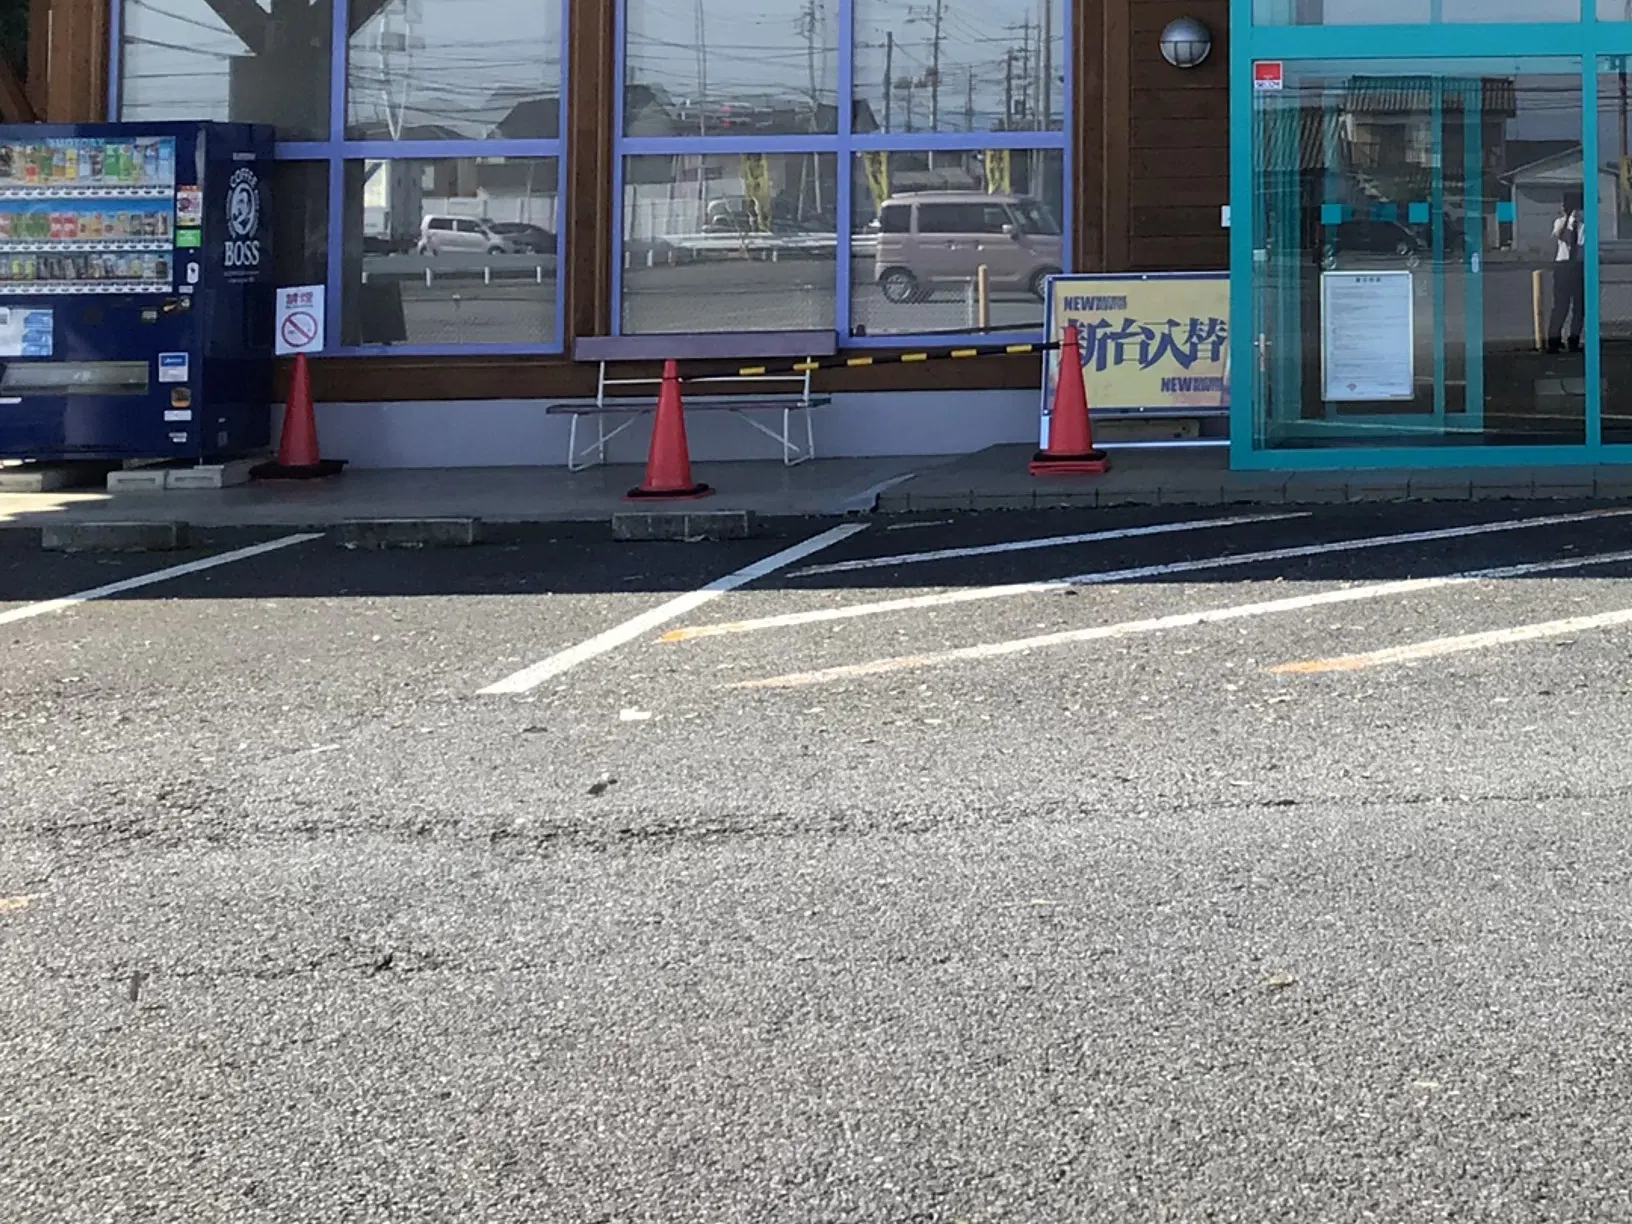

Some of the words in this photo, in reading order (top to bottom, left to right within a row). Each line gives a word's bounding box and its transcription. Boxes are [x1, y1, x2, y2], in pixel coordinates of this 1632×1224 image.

[224, 241, 260, 266] BOSS
[1064, 296, 1096, 311] NEW
[1161, 378, 1192, 392] NEW
